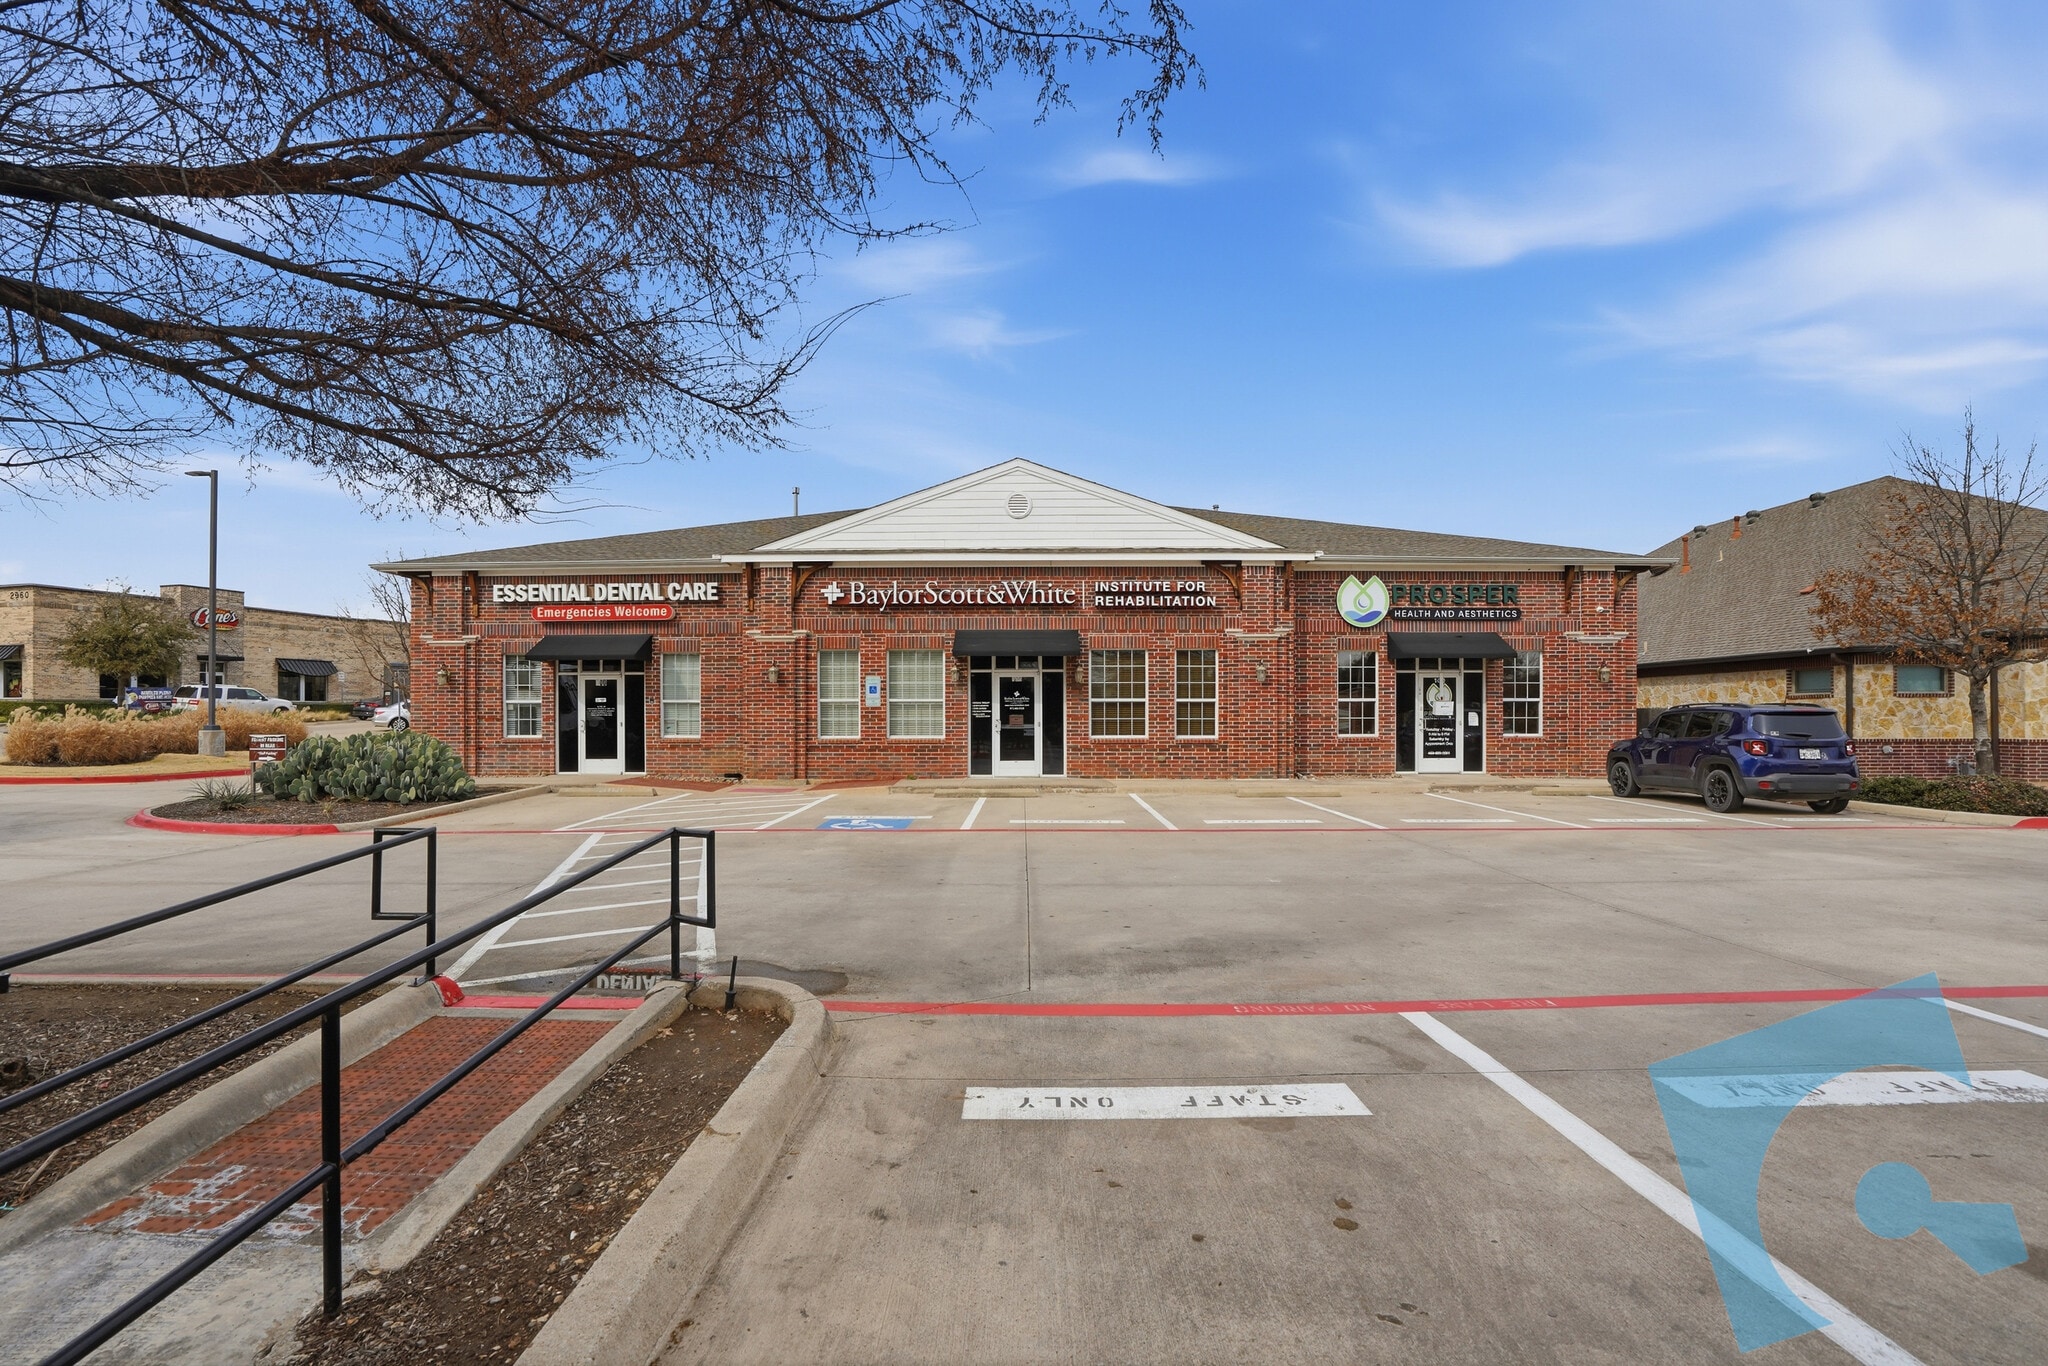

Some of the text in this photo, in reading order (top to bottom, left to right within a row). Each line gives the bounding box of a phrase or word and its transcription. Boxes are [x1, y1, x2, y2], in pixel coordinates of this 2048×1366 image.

[492, 582, 718, 602] ESSENTIAL DENTAL CARE
[1094, 581, 1206, 593] INSTITUTE FOR
[1391, 584, 1518, 604] PROSPER
[1095, 595, 1216, 607] REHABILITATION
[537, 606, 667, 619] Emergencies Welcome
[1394, 609, 1518, 618] HEALTH AND AESTHETICS
[1233, 1005, 1333, 1013] PARKING
[1017, 1094, 1308, 1109] STAFF ONLY
